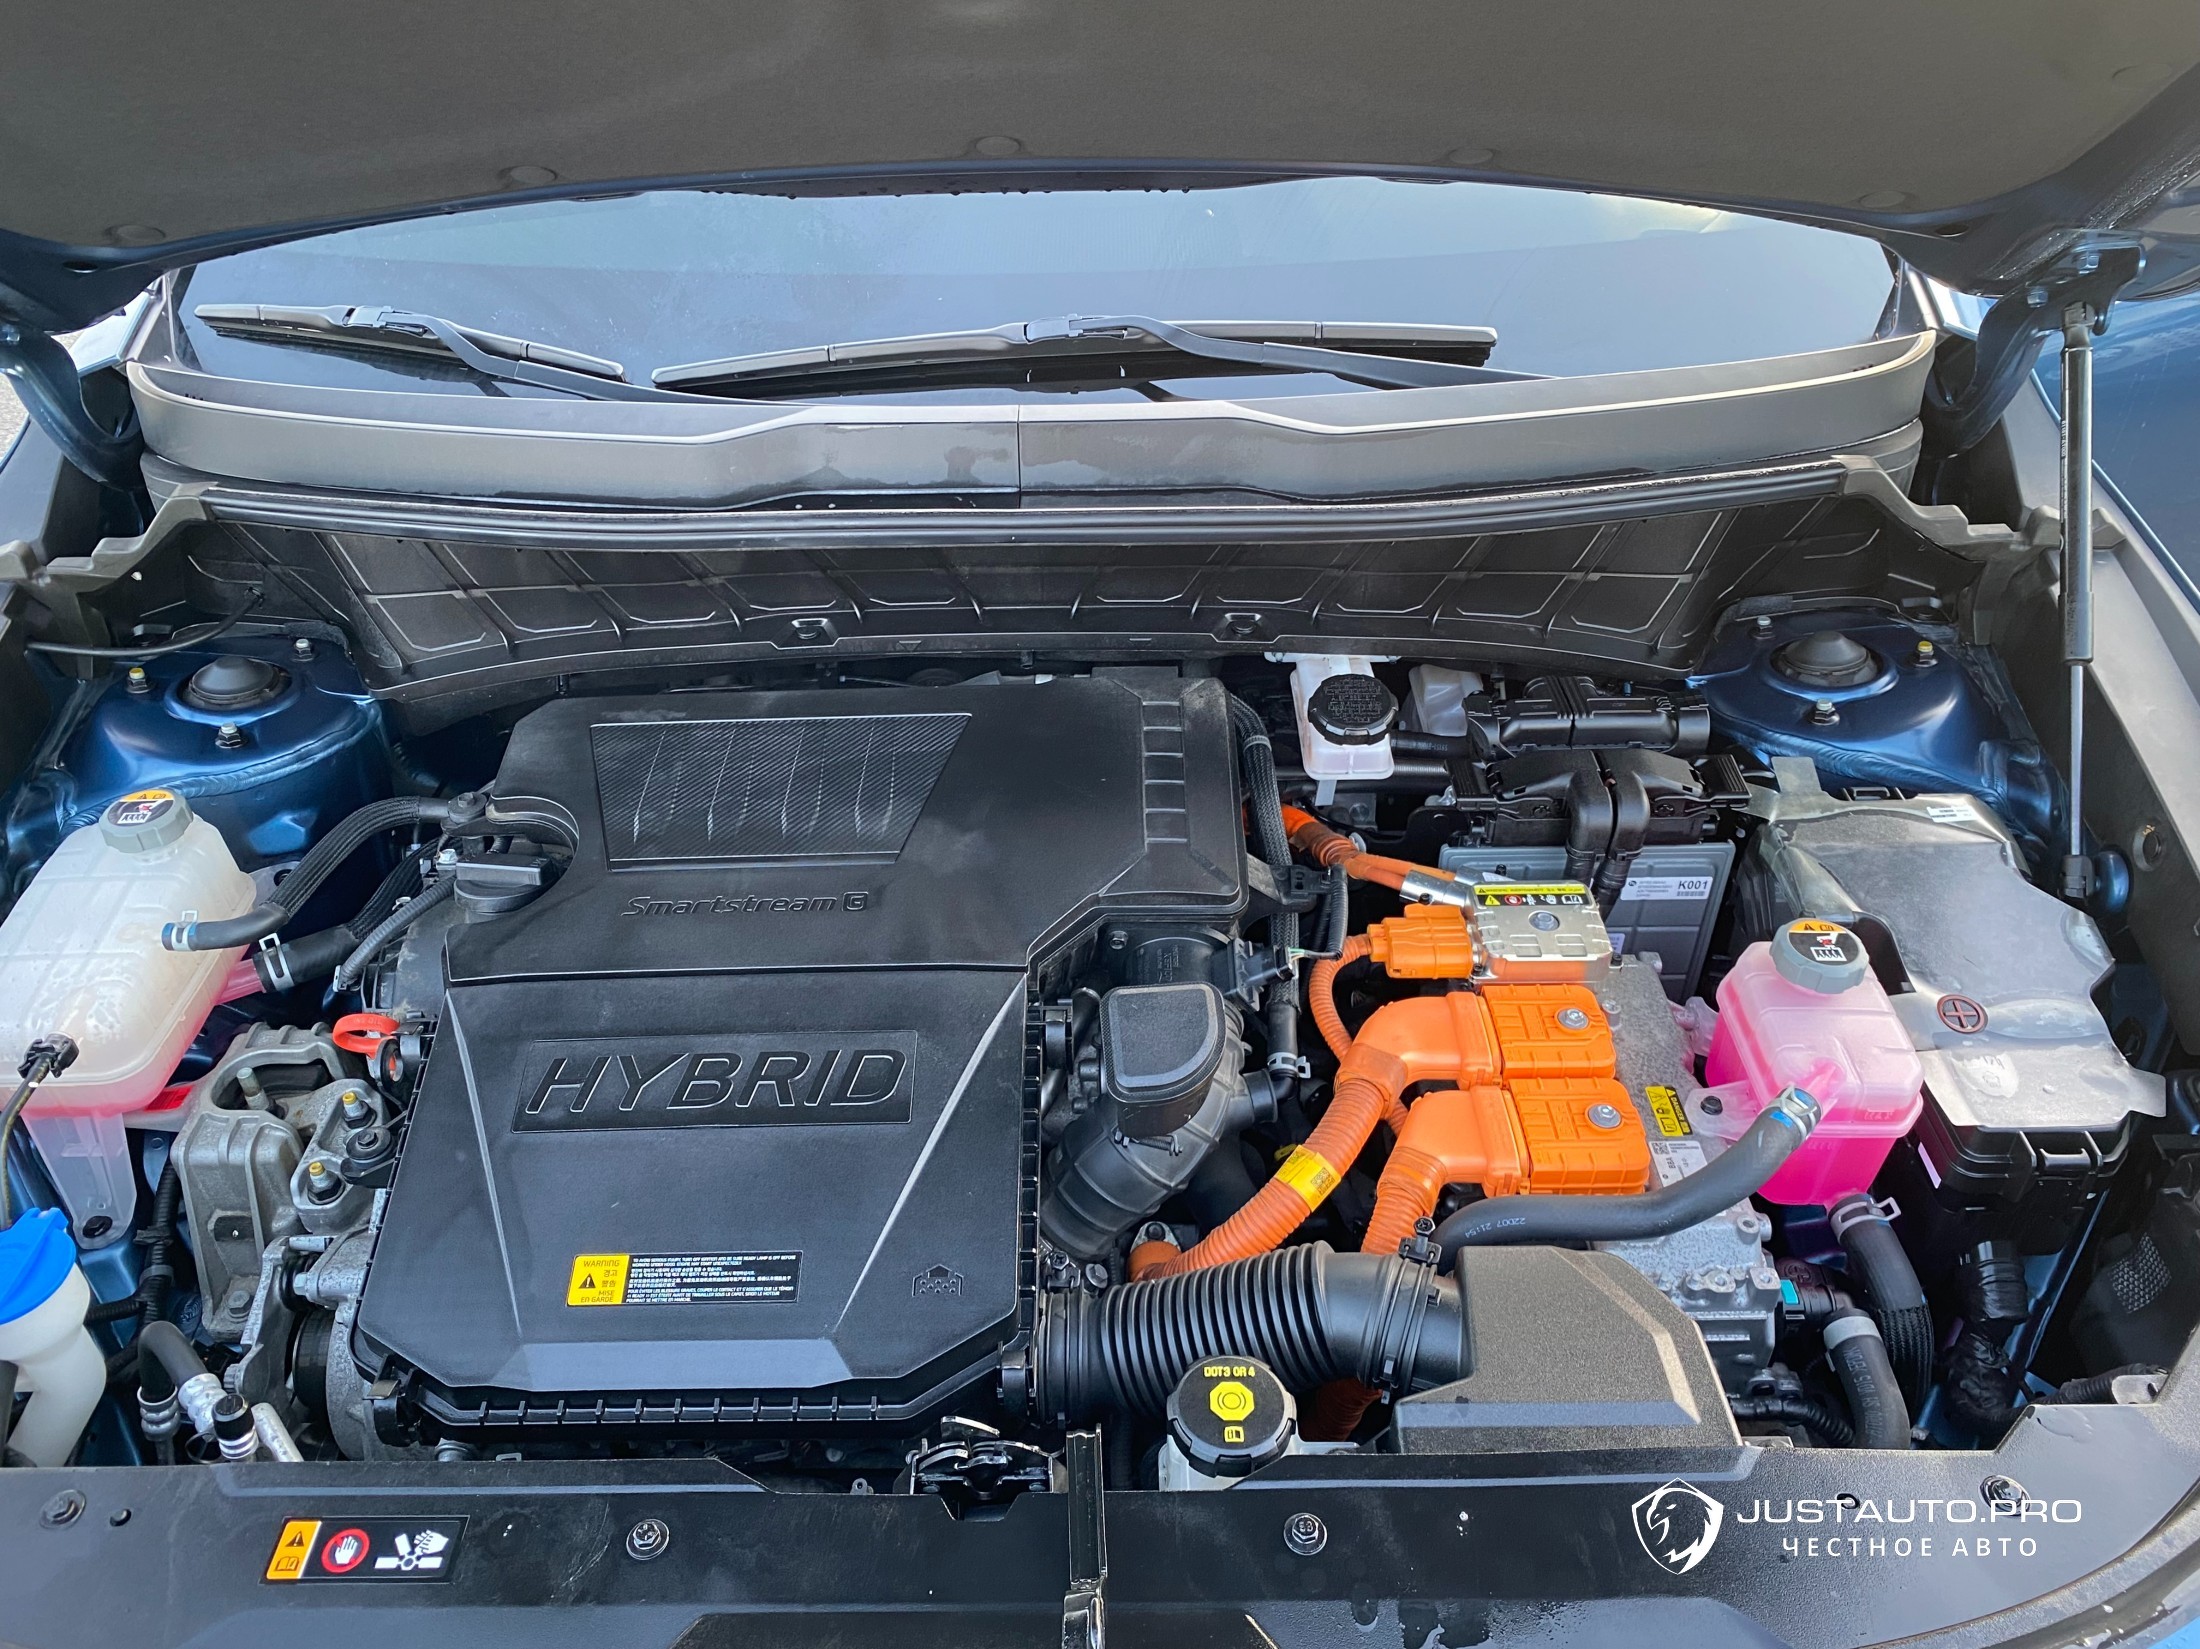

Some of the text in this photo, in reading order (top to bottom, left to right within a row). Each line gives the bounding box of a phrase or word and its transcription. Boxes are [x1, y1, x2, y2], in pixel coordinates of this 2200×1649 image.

[1678, 880, 1708, 890] K001
[621, 894, 837, 916] Smartstream
[525, 1048, 907, 1114] HYBRID
[1203, 1366, 1256, 1378] DOT3 OR 4
